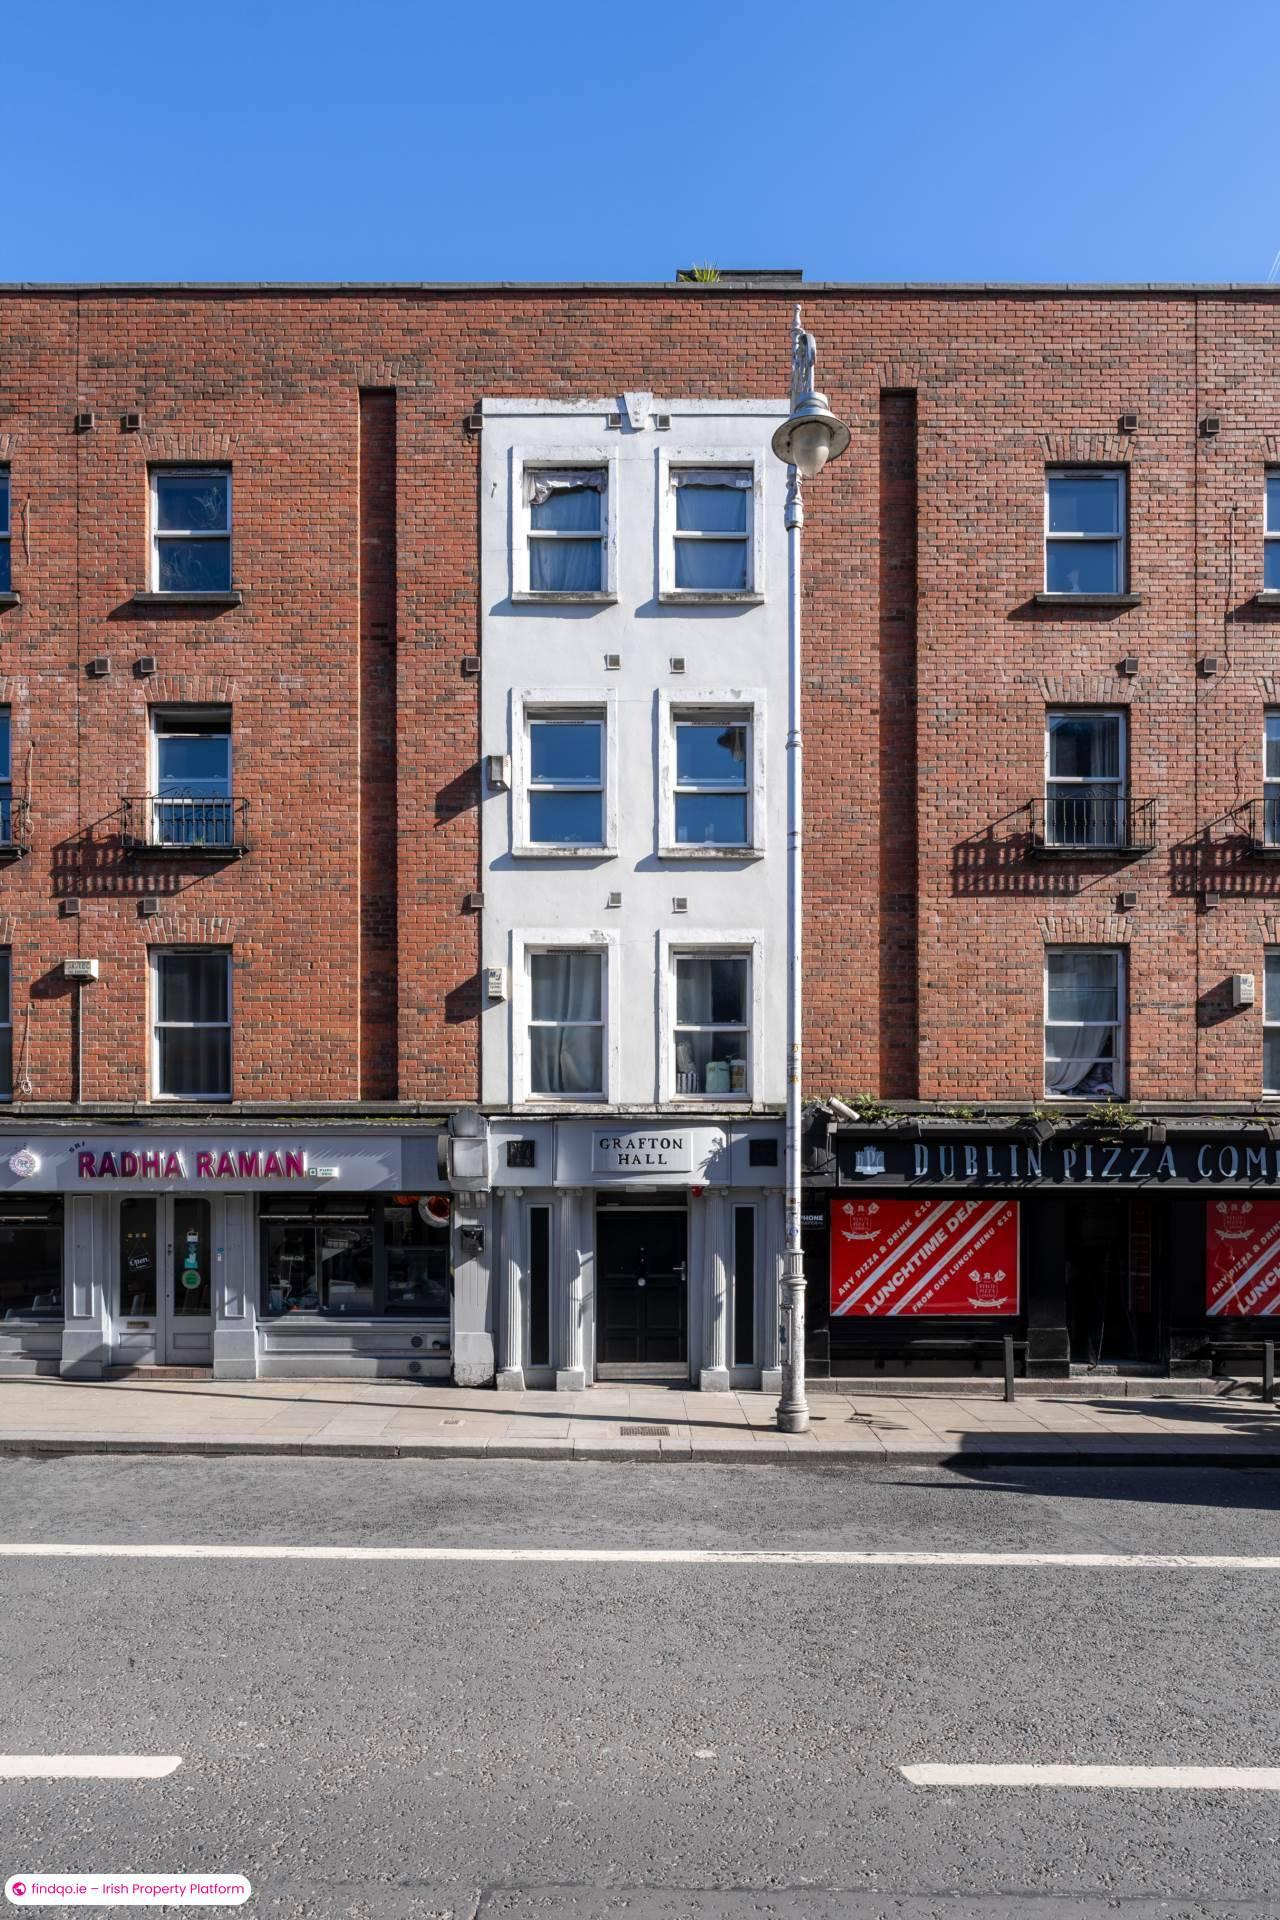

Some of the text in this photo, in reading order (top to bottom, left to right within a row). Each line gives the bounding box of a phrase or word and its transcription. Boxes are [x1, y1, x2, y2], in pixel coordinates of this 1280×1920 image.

[600, 1138, 683, 1150] GRAFTON
[618, 1154, 667, 1165] HALL
[914, 1144, 1042, 1177] DUBLIN
[1063, 1144, 1177, 1178] PIZZA
[78, 1151, 307, 1178] RADHA RAMAN
[129, 1256, 149, 1267] Open
[838, 1277, 855, 1296] ANY
[855, 1255, 880, 1278] PIZZA
[879, 1245, 888, 1254] &
[887, 1218, 913, 1246] DRINK
[864, 1228, 948, 1315] LUNCHTIME
[912, 1290, 934, 1313] FROM
[933, 1274, 950, 1291] OUR
[949, 1248, 974, 1275] LUNCH
[974, 1229, 996, 1250] MENU
[1211, 1276, 1228, 1296] ANY
[1228, 1252, 1253, 1278] PIZZA
[1260, 1220, 1280, 1245] DRIN
